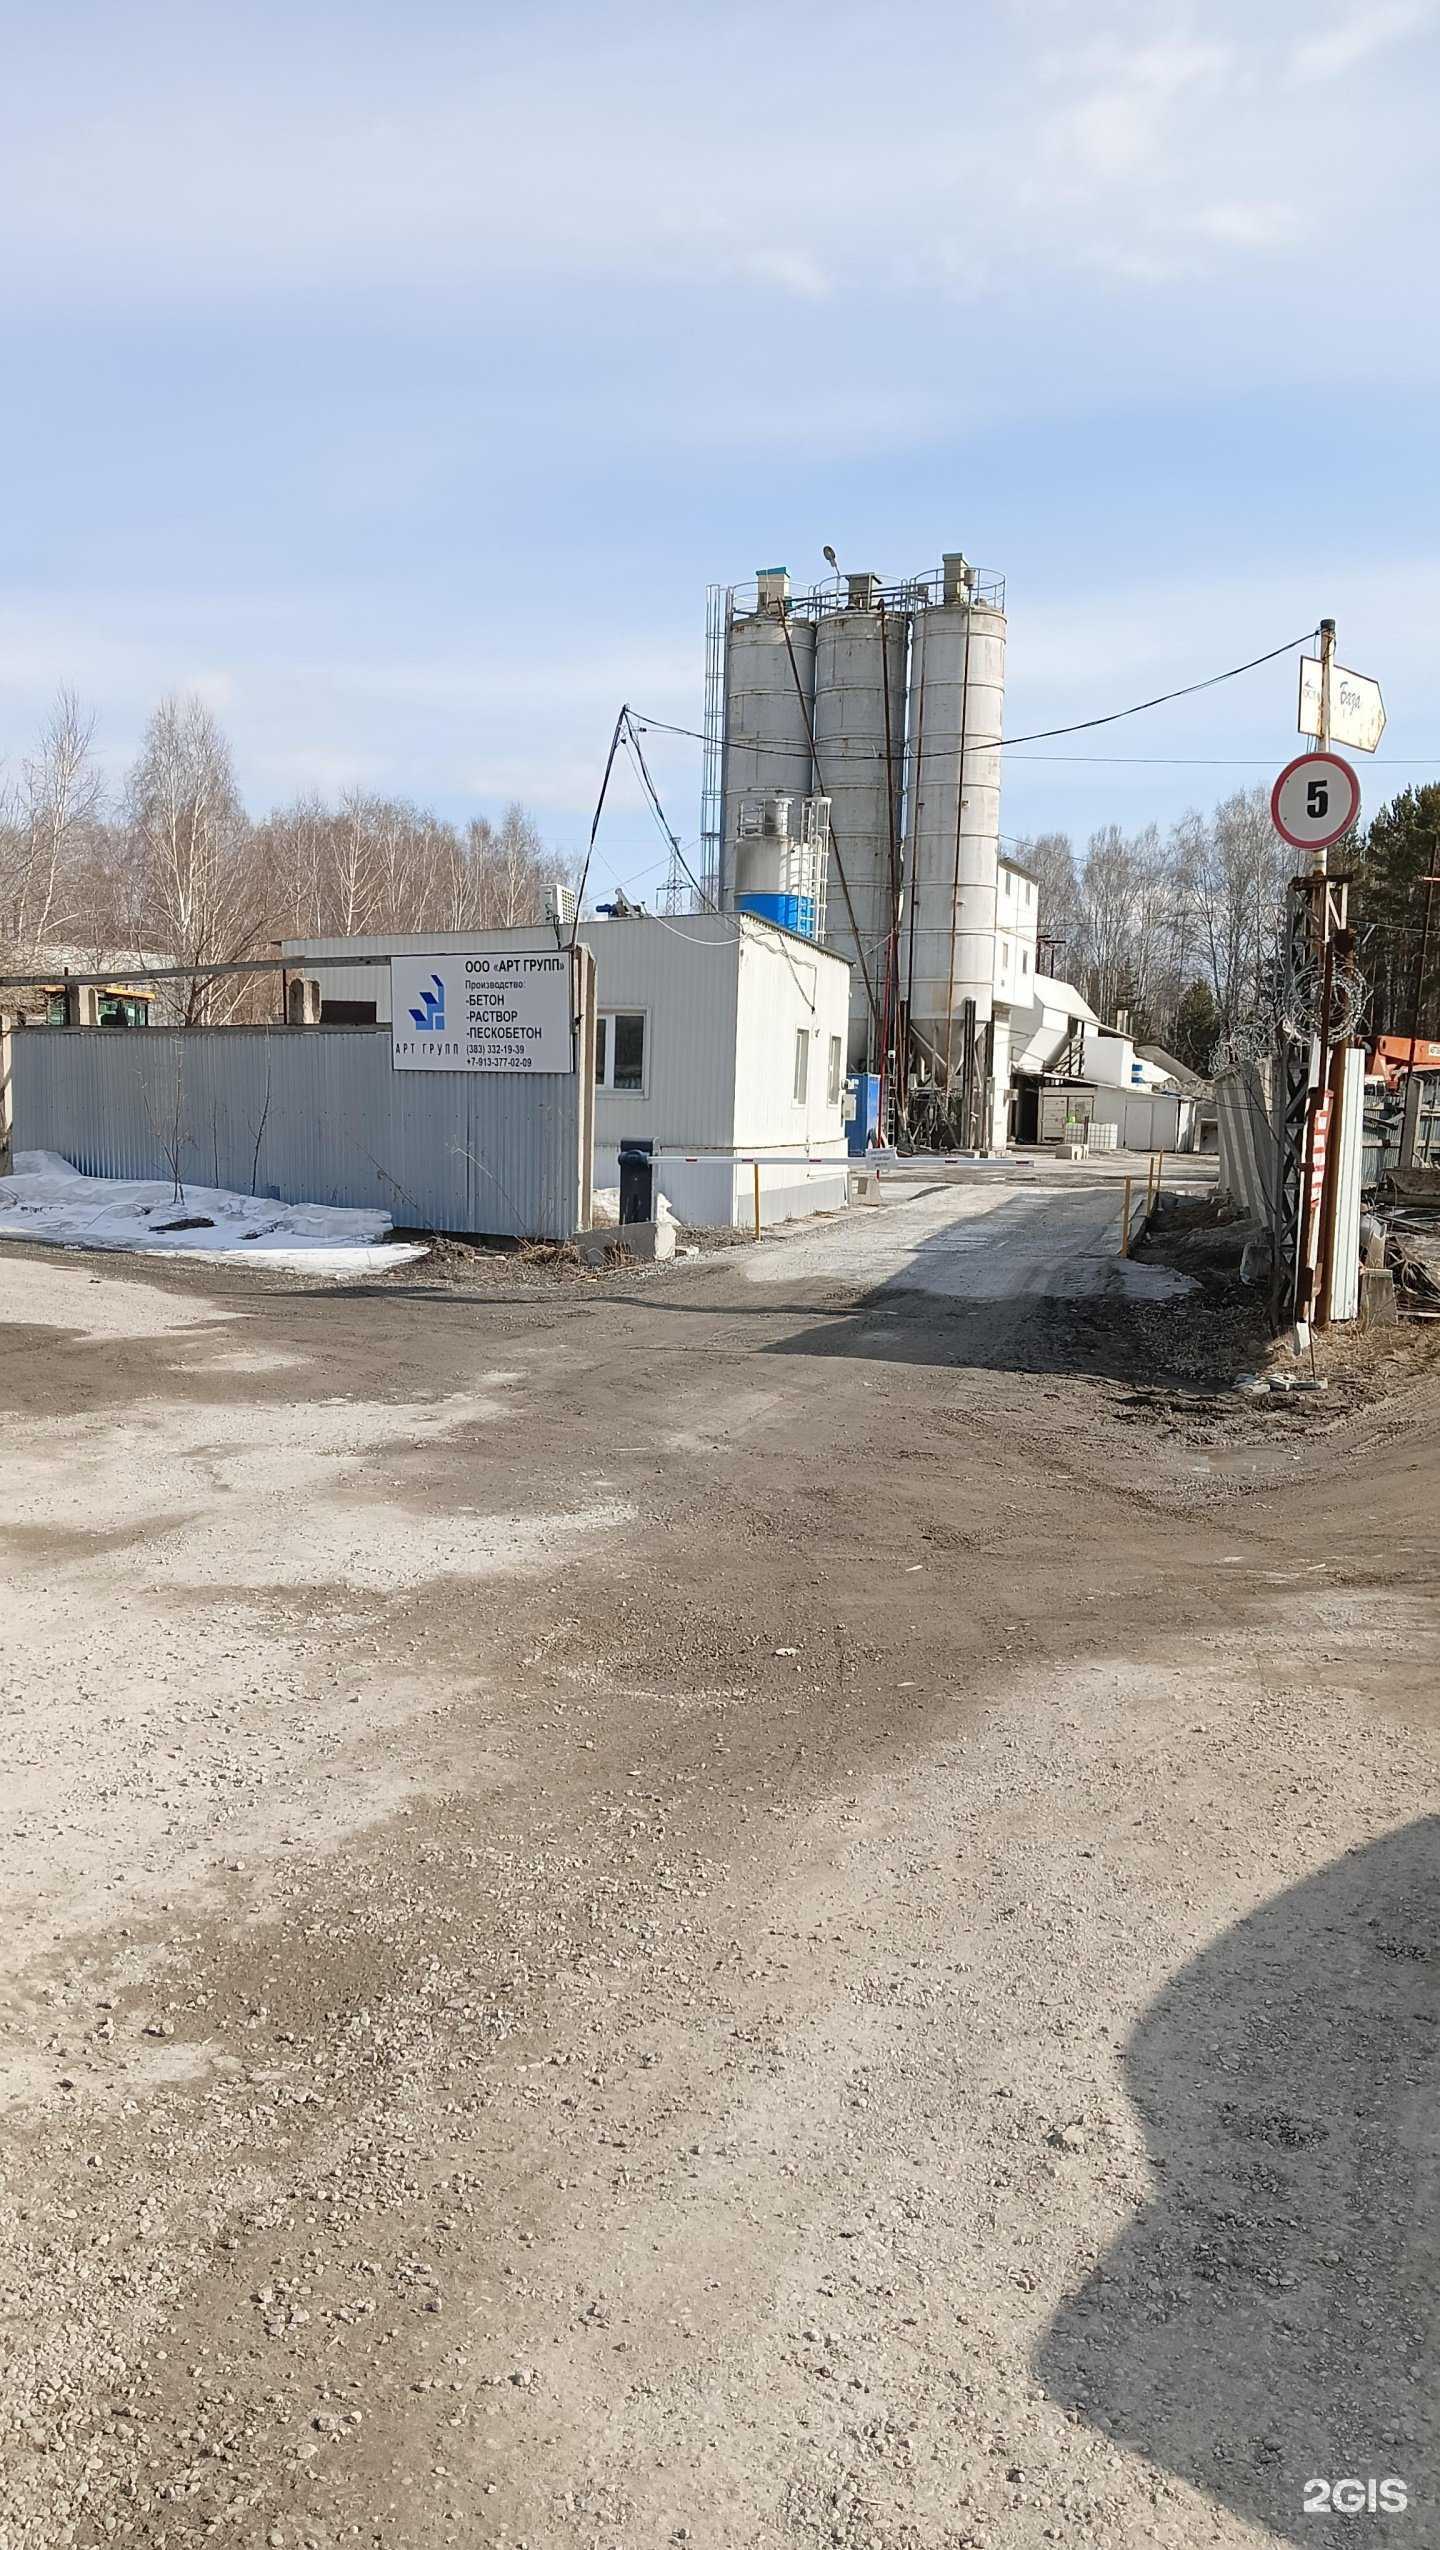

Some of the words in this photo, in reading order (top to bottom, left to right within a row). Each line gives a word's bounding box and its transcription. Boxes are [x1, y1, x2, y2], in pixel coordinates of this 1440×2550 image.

[1307, 780, 1329, 819] 5
[465, 960, 490, 973] ООО
[494, 959, 521, 972] «АРТ
[523, 958, 565, 972] ГРУПП»
[465, 979, 527, 992] Производство:
[465, 994, 505, 1006] -БЕТОН
[466, 1010, 518, 1023] -РАСТВОР
[466, 1026, 542, 1039] -ПЕСКОБЕТОН
[395, 1043, 415, 1055] АРТ
[422, 1043, 459, 1056] ГРУПП
[466, 1044, 486, 1055] (383)
[487, 1044, 525, 1054] 332-19-39
